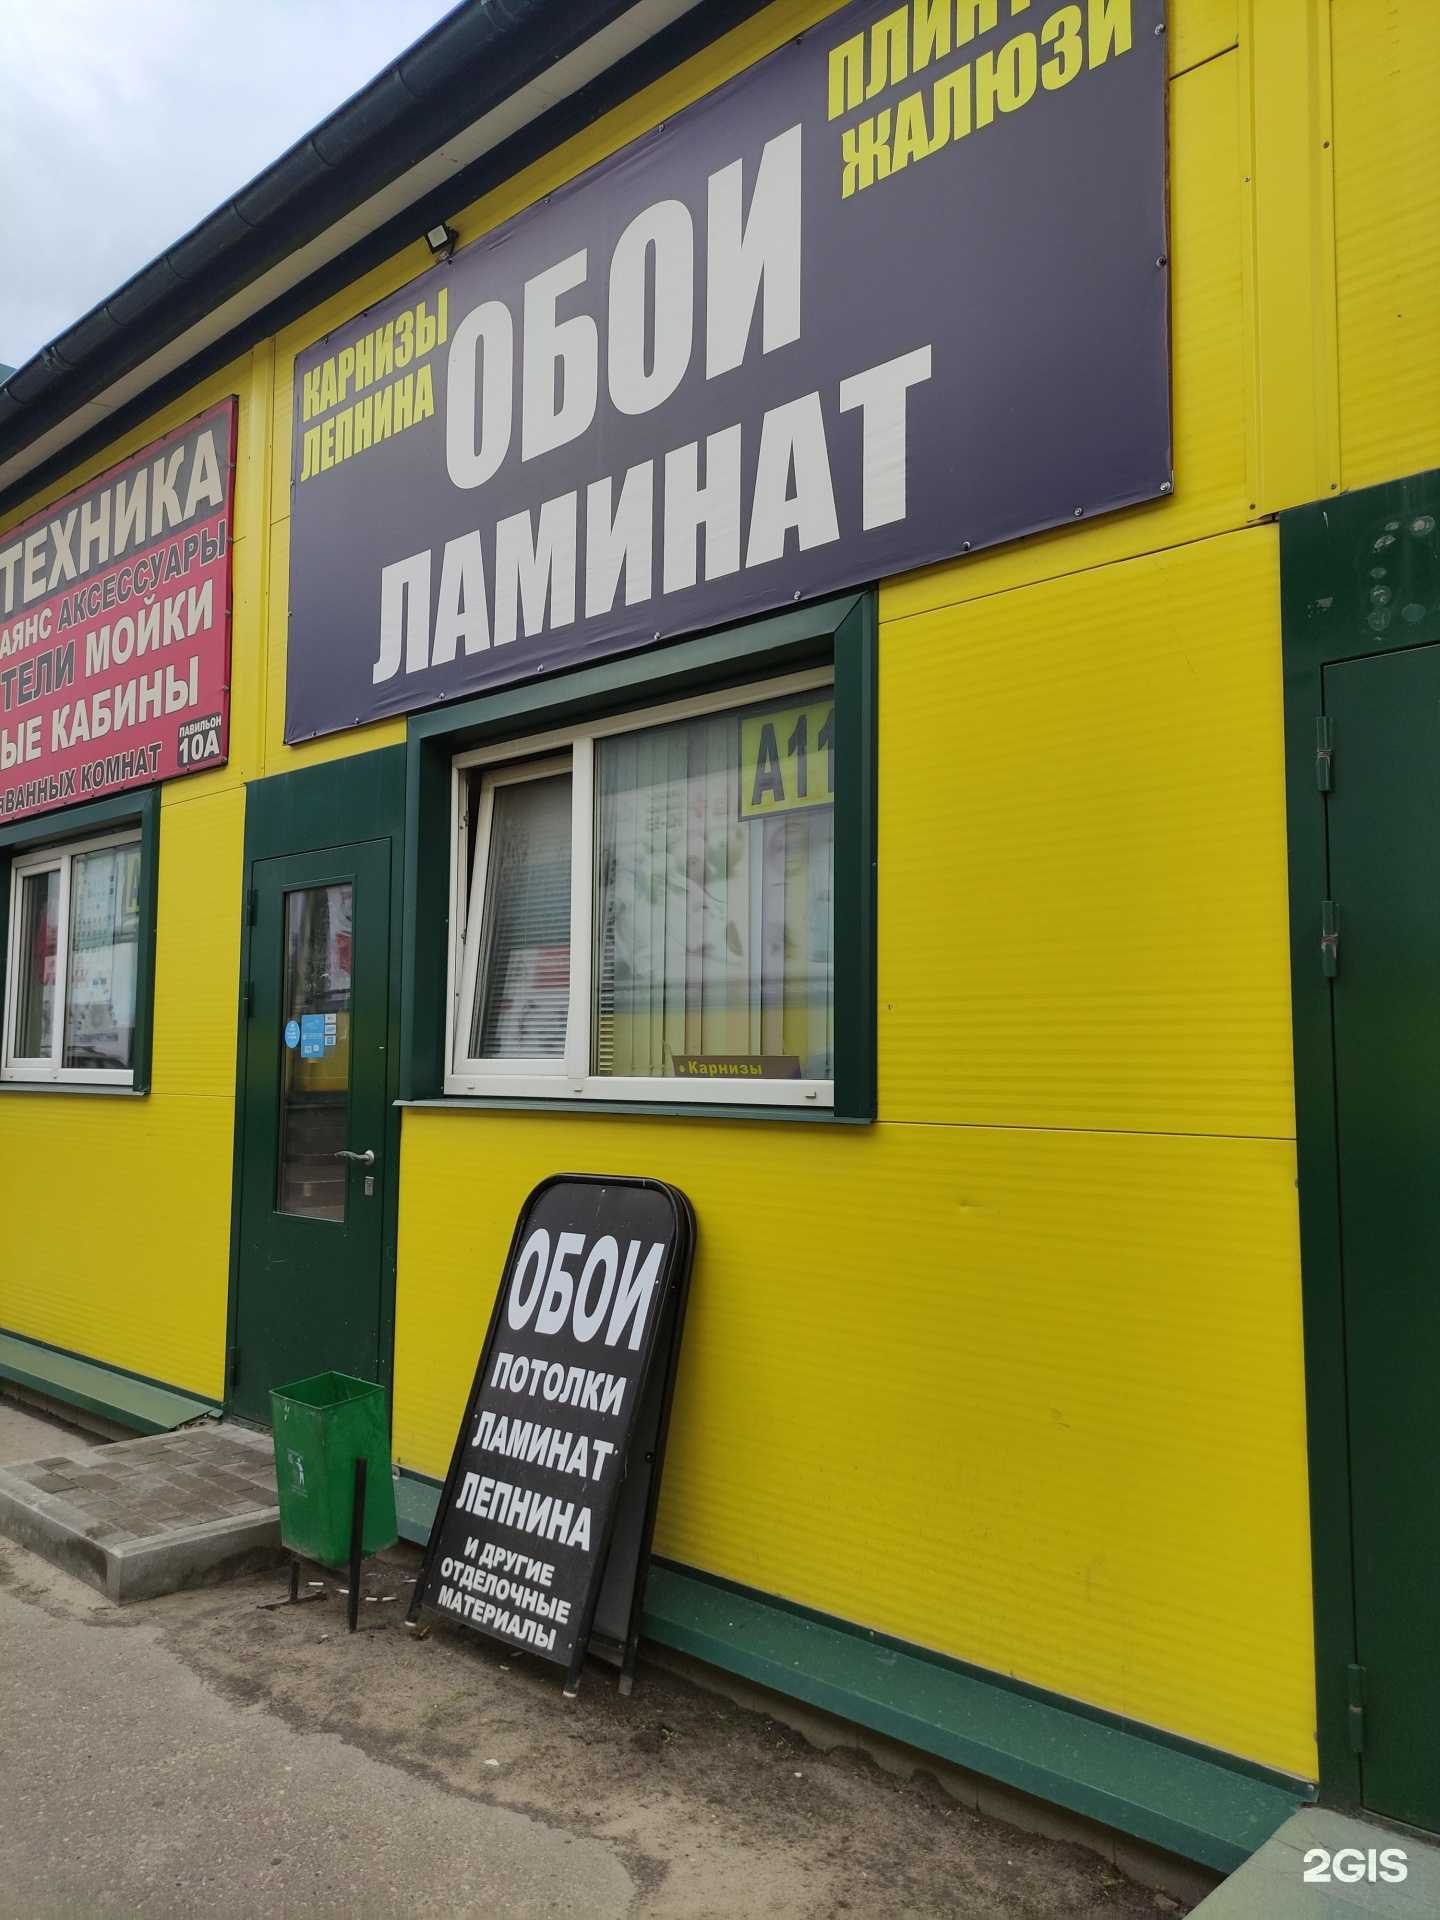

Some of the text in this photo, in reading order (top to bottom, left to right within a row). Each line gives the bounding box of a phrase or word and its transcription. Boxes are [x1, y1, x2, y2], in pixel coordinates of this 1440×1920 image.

[828, 0, 1031, 121] ПЛИН
[842, 0, 1132, 200] ЖАЛЮЗИ
[303, 288, 447, 422] КАРНИЗЫ
[446, 123, 801, 489] ОБОИ
[301, 363, 434, 482] ЛЕПНИНА
[0, 430, 224, 615] ТЕХНИКА
[372, 345, 932, 685] ЛАМИНАТ
[0, 519, 226, 659] АЯНС АКСЕССУАРЫ
[1, 578, 213, 712] ТЕЛИ МОЙКИ
[0, 656, 199, 770] ЫЕ КАБИНЫ
[81, 742, 162, 793] КОМНАТ
[179, 715, 221, 738] ПАВИЛЬОН
[688, 1060, 762, 1077] Карнизы
[507, 1227, 665, 1351] ОБОИ
[490, 1352, 626, 1416] ПОТОЛКИ
[472, 1411, 614, 1481] ЛАМИНАТ
[456, 1472, 591, 1551] ЛЕПНИНА
[464, 1536, 555, 1587] И ДРУГИЕ
[438, 1586, 556, 1650] МАТЕРИАЛЫ
[440, 1556, 571, 1624] ОТДЕЛОЧНЫЕ
